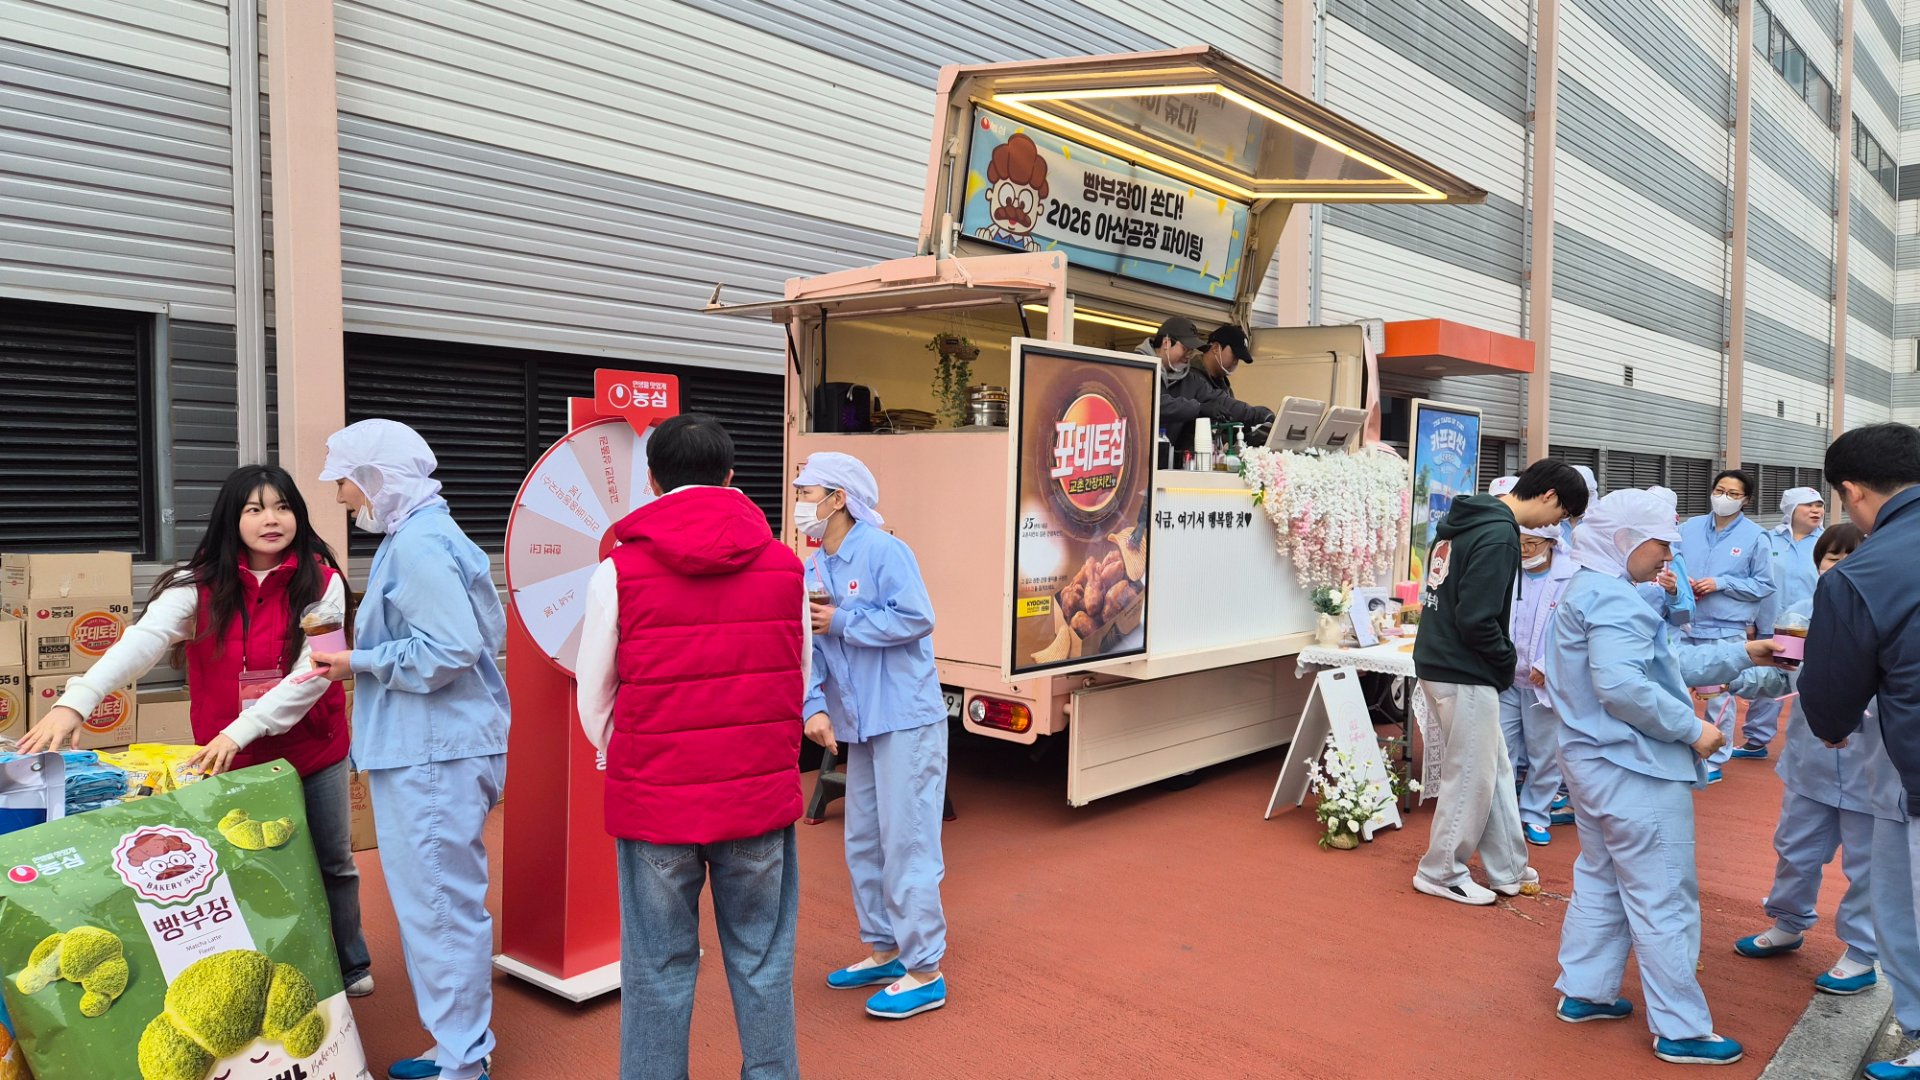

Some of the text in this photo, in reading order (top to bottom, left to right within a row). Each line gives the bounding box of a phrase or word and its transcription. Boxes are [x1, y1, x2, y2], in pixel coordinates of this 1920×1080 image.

[1083, 171, 1185, 220] 빵부장이 쏜다!
[1046, 198, 1204, 262] 2026 아산공장 파이팅
[632, 389, 667, 408] 농심
[1051, 417, 1127, 478] 포테토칩
[1430, 429, 1466, 456] 카프리썬
[1069, 478, 1085, 493] 교촌
[1155, 510, 1174, 529] 지금,
[1178, 511, 1205, 530] 여기서
[1208, 511, 1234, 529] 행복할
[530, 544, 561, 555] 한번 더!
[51, 609, 74, 618] 농심
[75, 621, 120, 643] 포테토칩
[90, 698, 124, 717] 테토칩
[38, 853, 85, 876] 농심
[146, 864, 208, 891] BAKERY SNACK
[153, 896, 233, 942] 빵부장
[186, 934, 222, 952] Matcha Latte
[311, 1041, 339, 1077] Bakery
